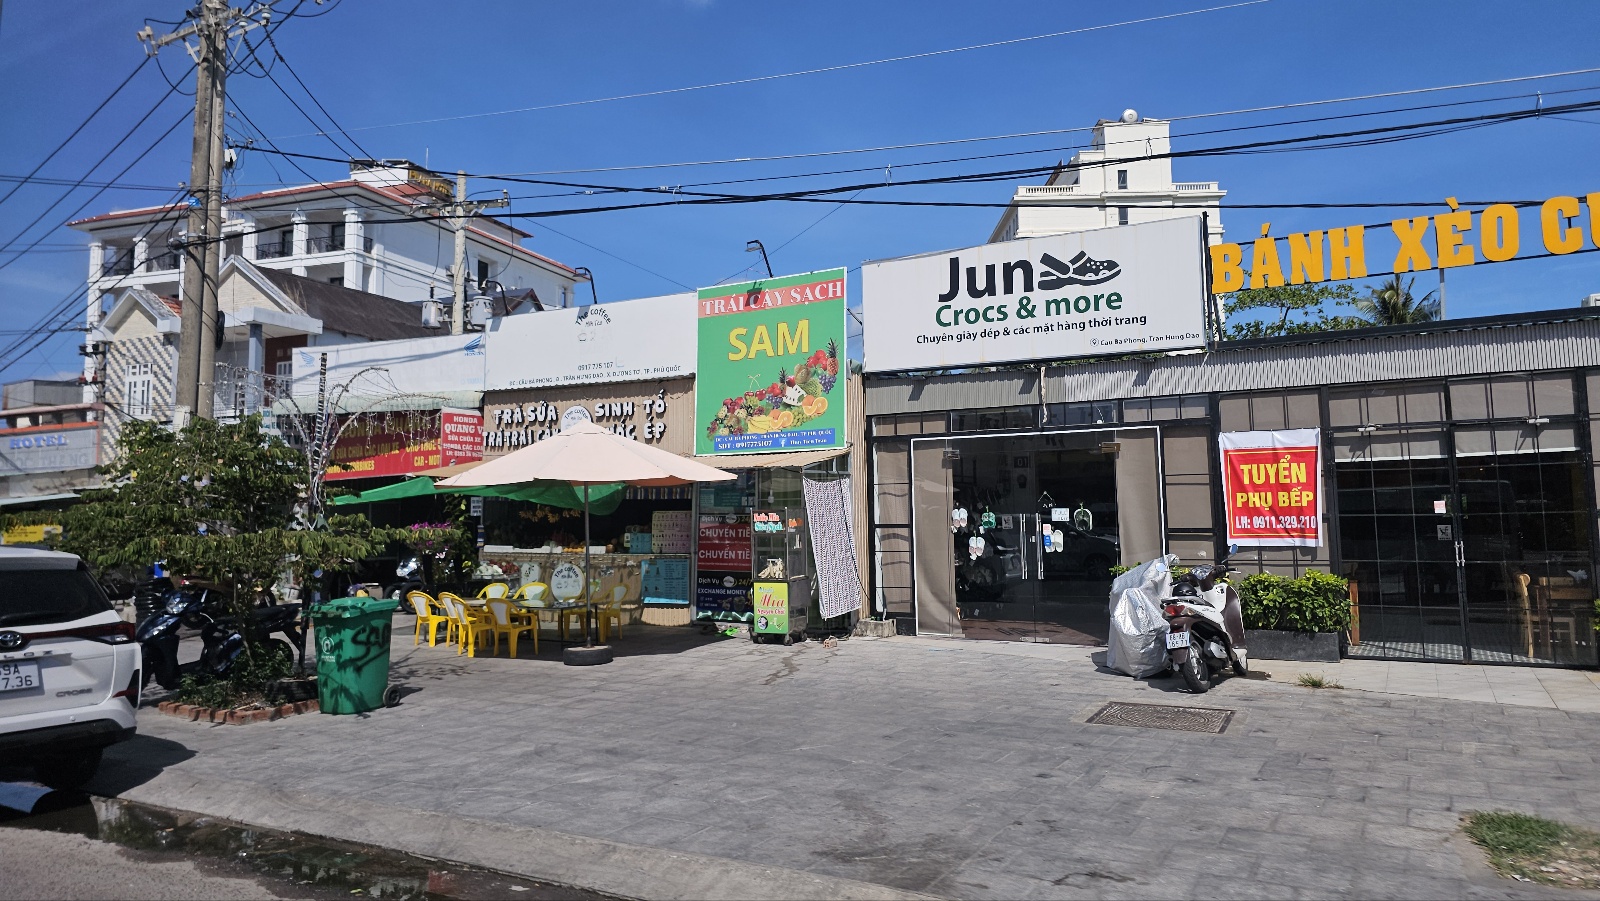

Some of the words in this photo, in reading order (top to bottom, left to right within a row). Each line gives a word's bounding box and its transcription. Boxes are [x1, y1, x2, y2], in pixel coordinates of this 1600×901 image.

[1210, 222, 1367, 294] BÁNH
[1392, 196, 1519, 274] XÈO
[938, 256, 1035, 303] Jun
[703, 294, 745, 316] TRÁI
[750, 288, 786, 309] CÂY
[790, 281, 843, 306] SẠCH
[575, 311, 590, 325] The
[590, 307, 612, 325] coffee
[935, 301, 1008, 328] Crocs
[1015, 295, 1037, 320] &
[1045, 291, 1123, 318] more
[728, 318, 809, 362] SAM
[916, 331, 954, 345] Chuyên
[956, 328, 978, 343] giày
[980, 324, 1000, 341] dép
[1002, 326, 1011, 337] &
[1013, 322, 1030, 336] các
[1033, 321, 1055, 335] mặt
[1057, 319, 1086, 333] hàng
[1088, 315, 1112, 328] thời
[1115, 314, 1147, 327] trang
[453, 416, 478, 424] HONDA
[594, 402, 634, 417] SINH
[444, 423, 475, 434] QUANG
[643, 415, 667, 440] ÉP
[9, 434, 68, 449] HOTEL
[414, 456, 424, 467] CAR
[1239, 454, 1307, 485] TUYỂN
[1236, 491, 1272, 511] PHỤ
[1277, 486, 1314, 507] BẾP
[699, 525, 736, 538] CHUYỂN
[1235, 516, 1251, 529] LH:
[1253, 515, 1317, 529] 0911.329.210
[698, 547, 736, 559] CHUYỂN
